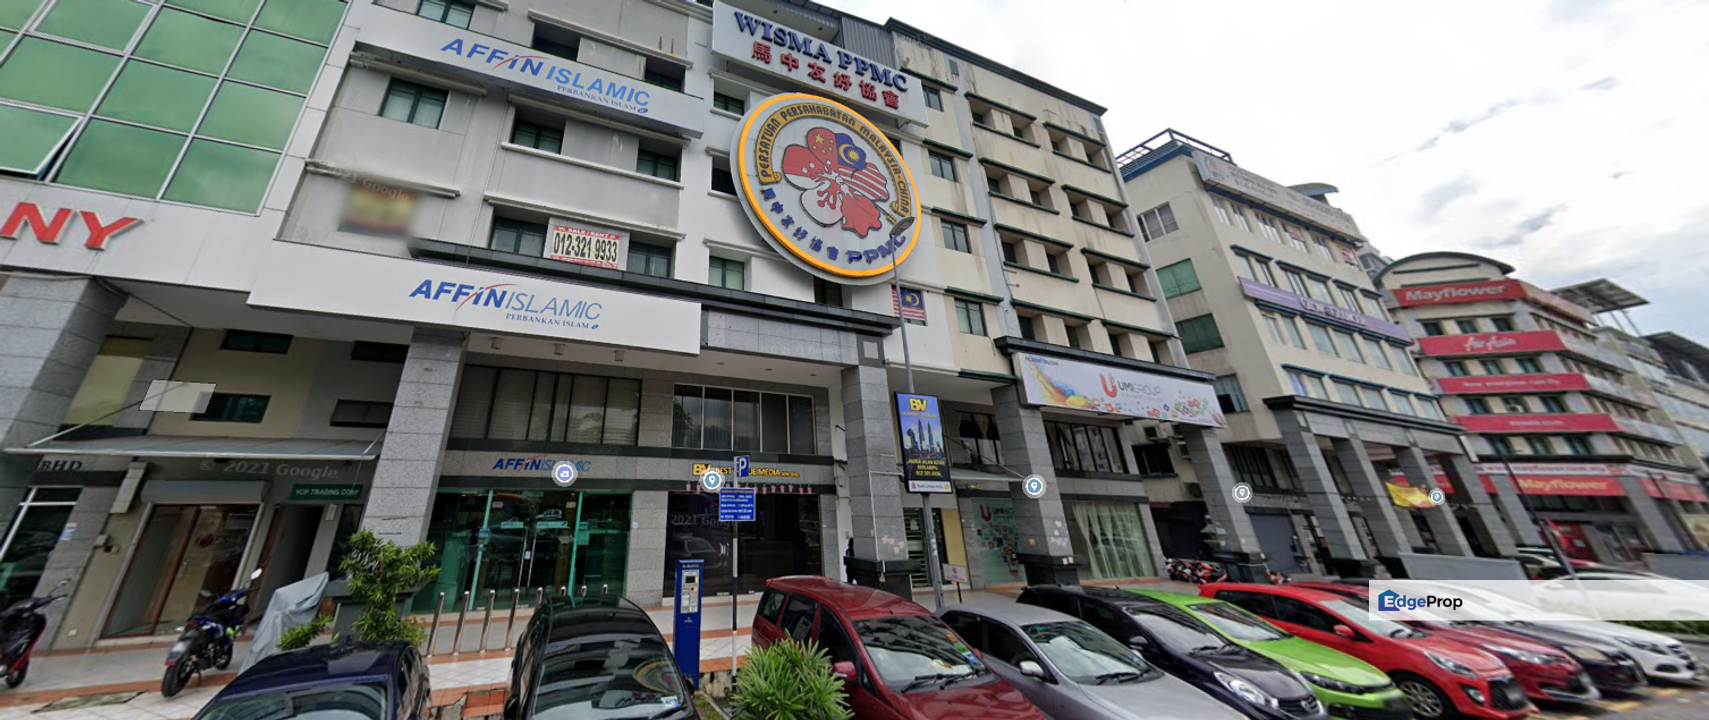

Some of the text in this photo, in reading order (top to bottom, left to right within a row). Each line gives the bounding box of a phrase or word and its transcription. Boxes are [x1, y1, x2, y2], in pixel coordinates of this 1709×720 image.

[734, 11, 909, 92] WISMA PPMC
[546, 66, 650, 106] ISLAMIC
[752, 41, 899, 109] 馬中友好協會
[557, 84, 637, 111] PERBANKAN ISLAM
[758, 117, 781, 178] PERSATUAN
[780, 104, 856, 126] PERSAHABATAN
[553, 232, 592, 258] 012-321
[595, 238, 618, 262] 9933
[845, 234, 907, 264] PPMC
[505, 291, 602, 320] ISLAMIC
[1405, 283, 1506, 302] Mayflower
[506, 313, 589, 329] PERBANKAN ISLAM
[909, 398, 927, 412] BV
[41, 460, 83, 471] BHD
[758, 468, 780, 477] MEDIA
[1519, 478, 1609, 491] Mayflower
